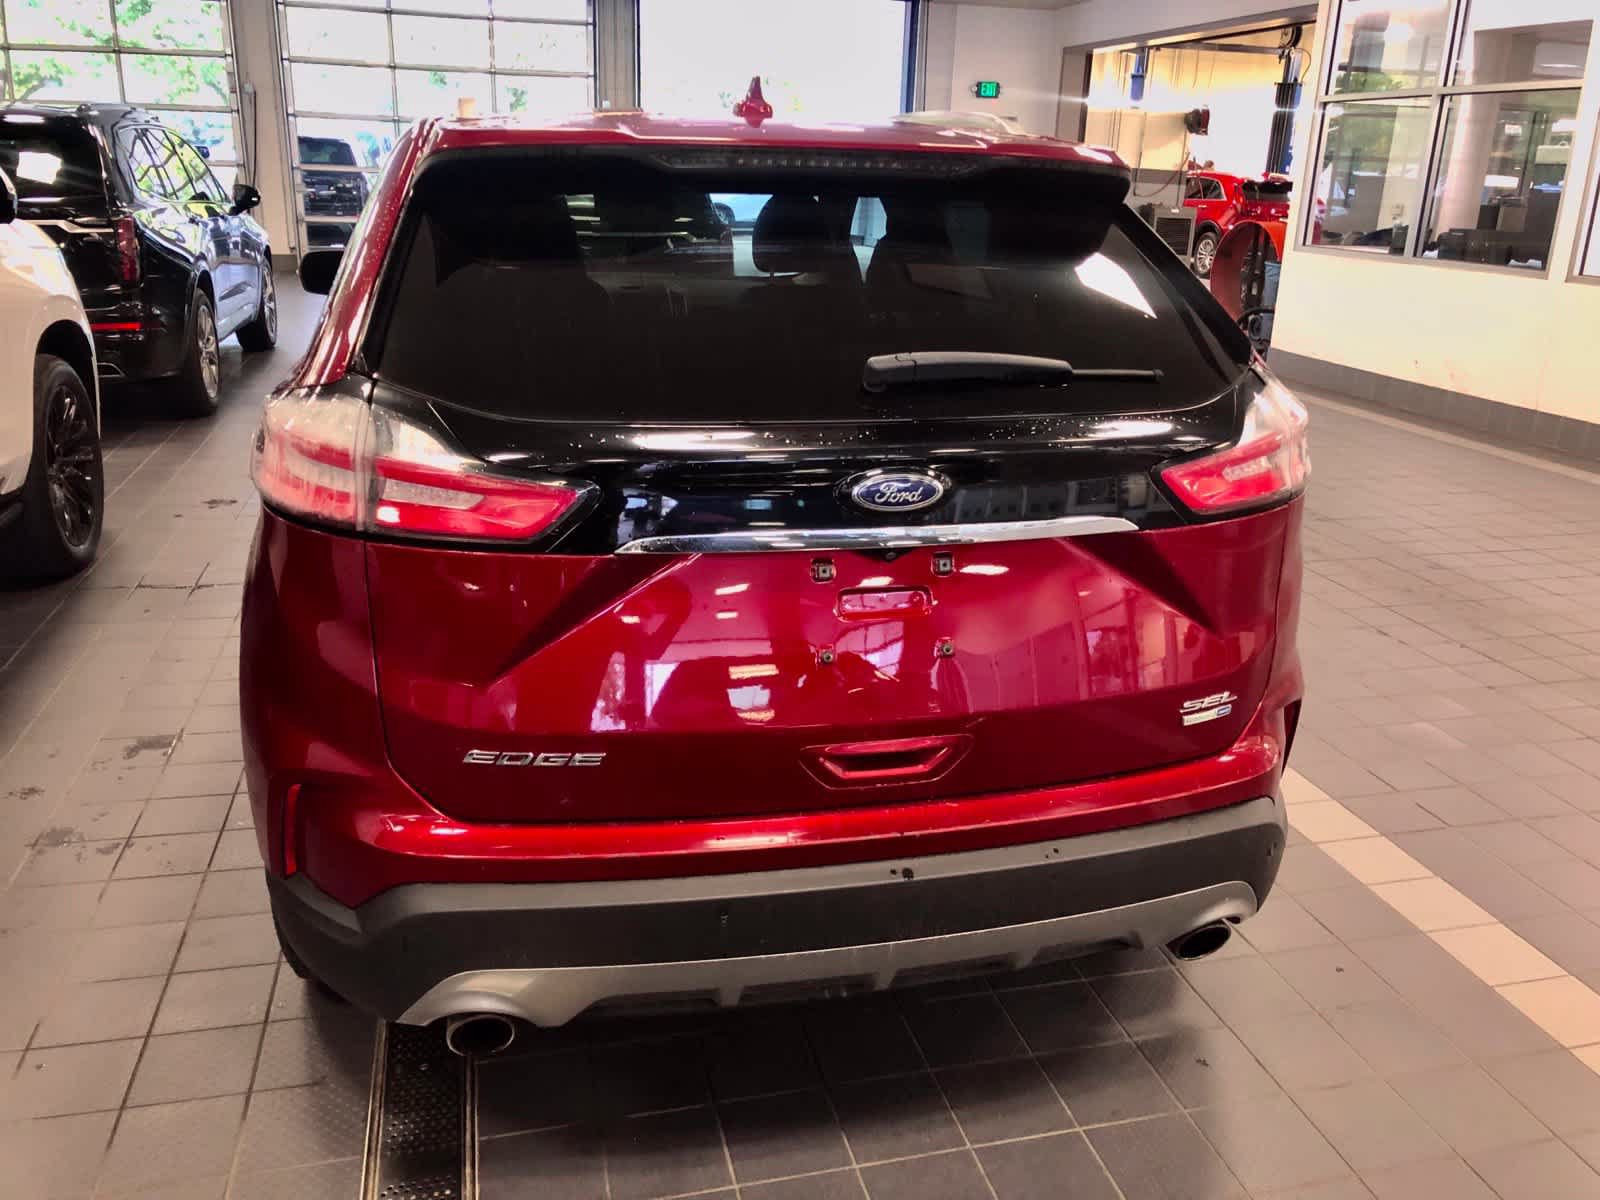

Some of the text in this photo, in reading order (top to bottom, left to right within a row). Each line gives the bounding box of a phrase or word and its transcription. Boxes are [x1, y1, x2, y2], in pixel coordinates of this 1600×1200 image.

[875, 481, 922, 502] Ford
[1180, 691, 1238, 713] SEL
[462, 750, 607, 766] EDGE
